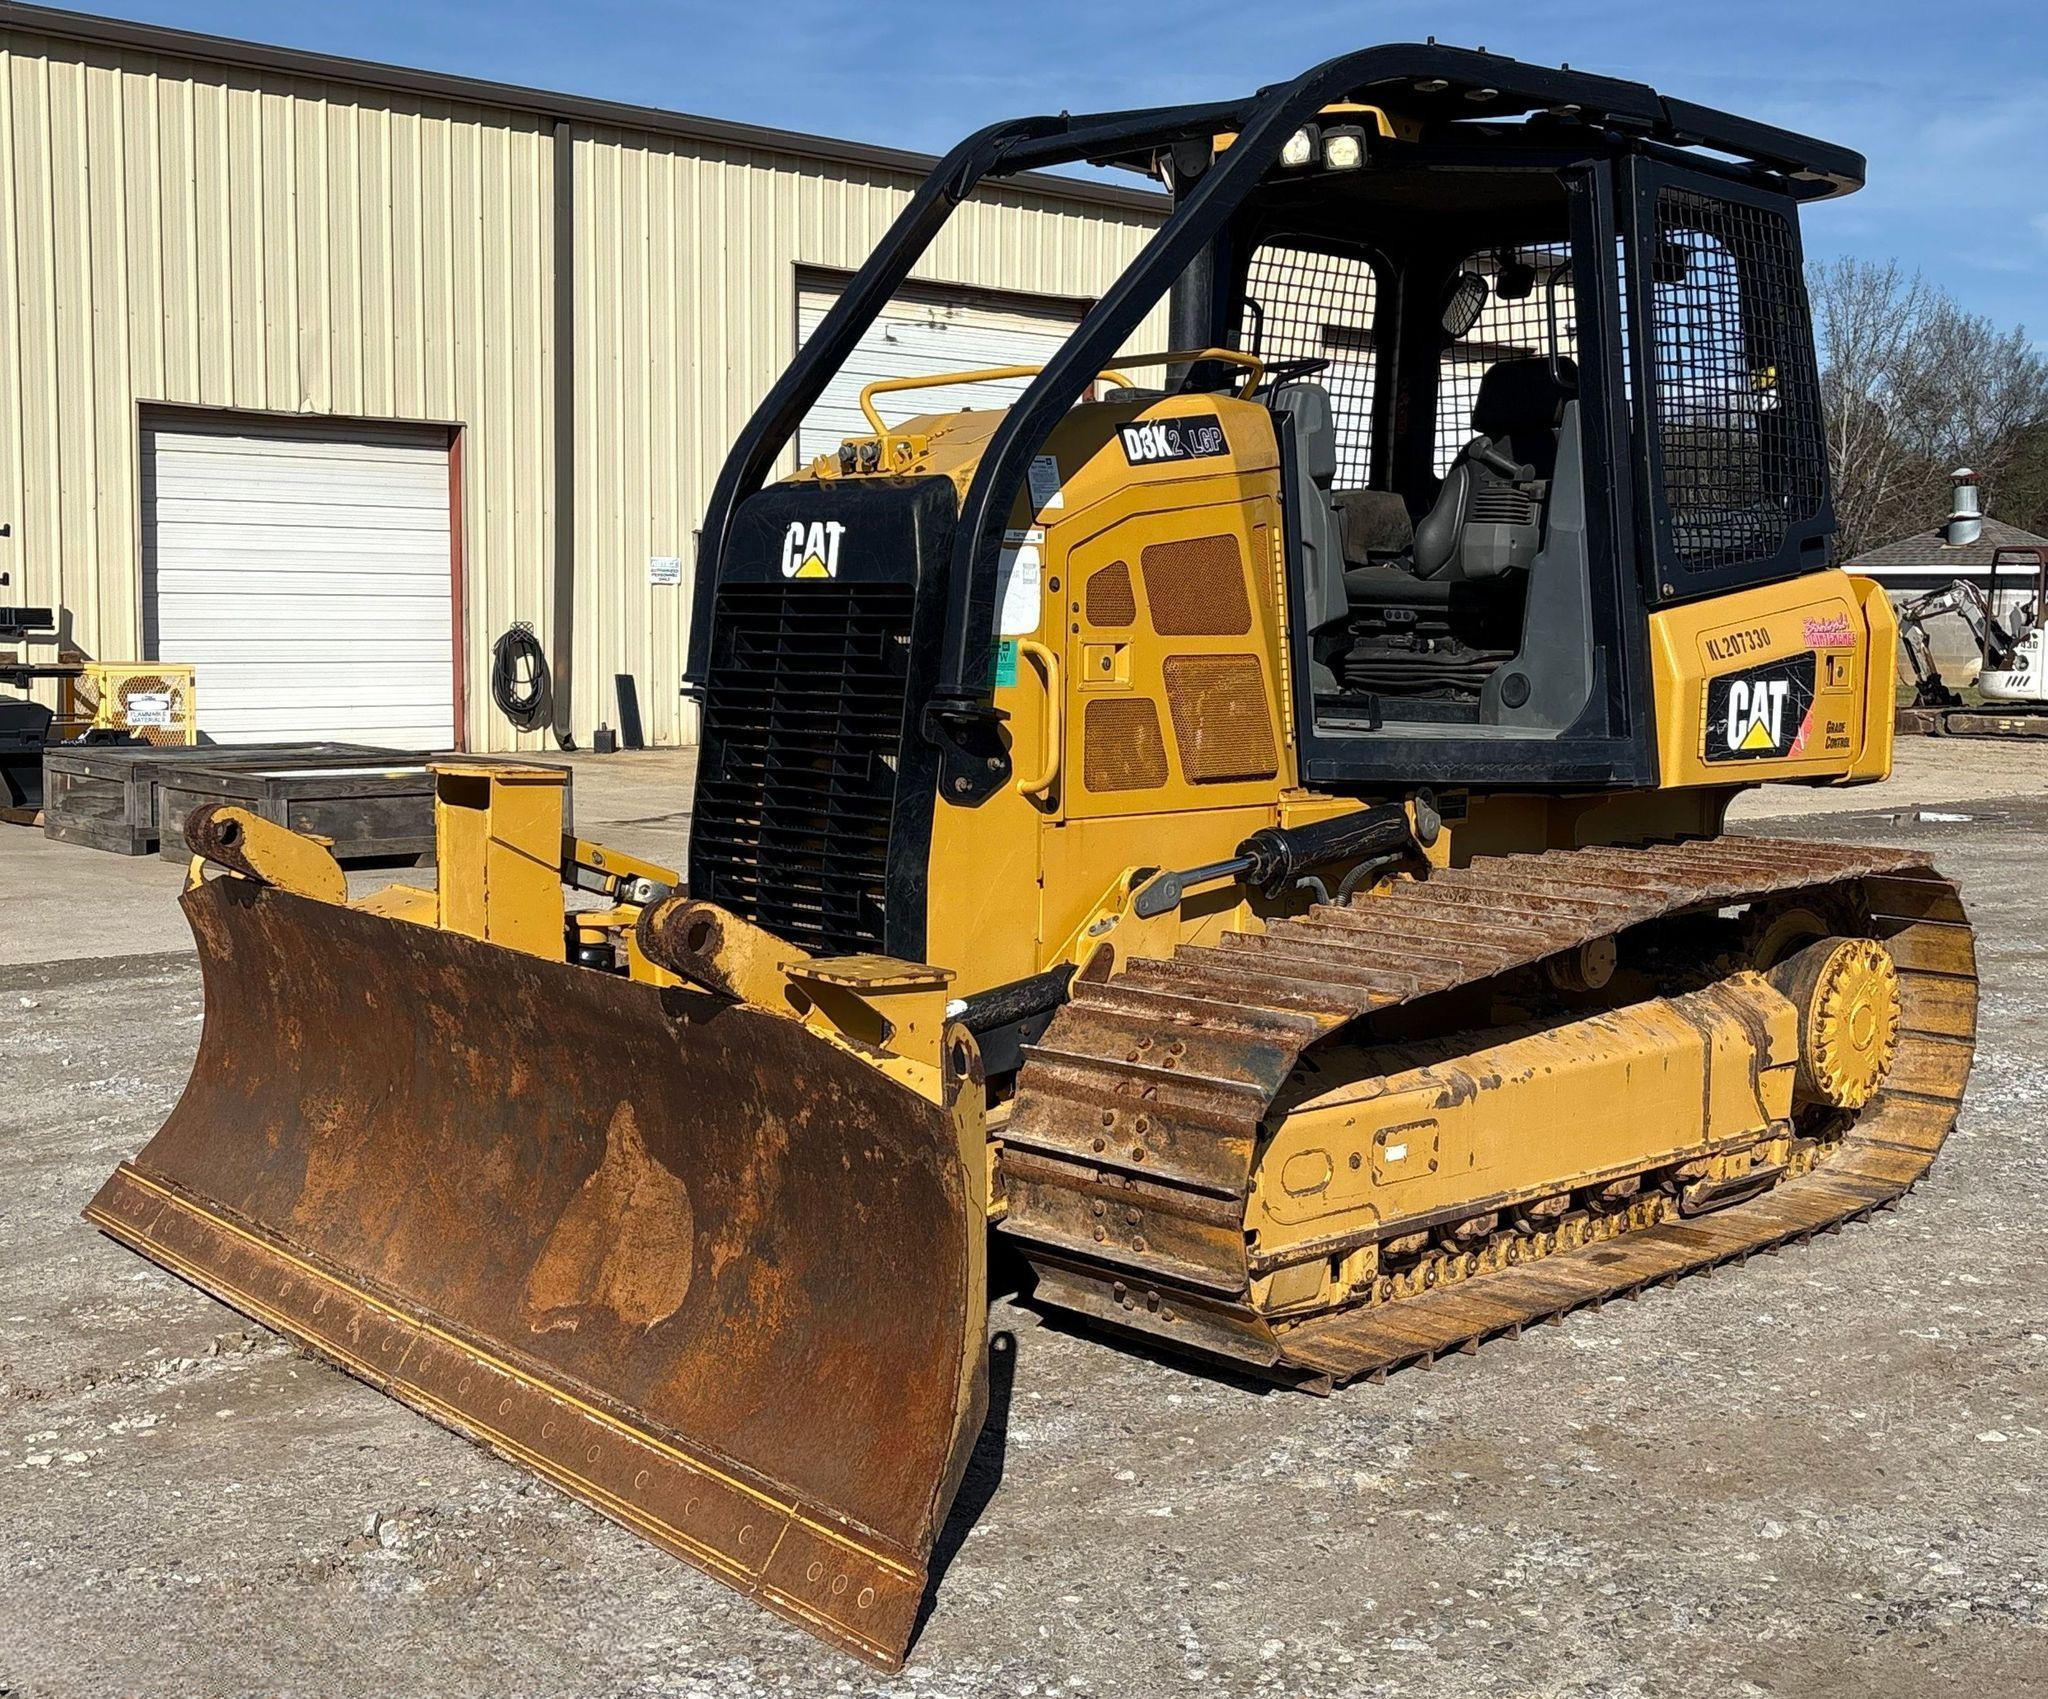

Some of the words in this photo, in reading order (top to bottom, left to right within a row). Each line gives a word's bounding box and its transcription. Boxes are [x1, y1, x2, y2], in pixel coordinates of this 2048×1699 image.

[1123, 425, 1184, 461] D3K2
[1188, 427, 1222, 454] LGP
[782, 521, 846, 578] CAT
[1706, 627, 1771, 661] KL207330
[2020, 641, 2038, 649] 430
[1727, 680, 1789, 750] CAT
[1826, 720, 1846, 734] GRADE
[1825, 736, 1850, 749] CONTROL
